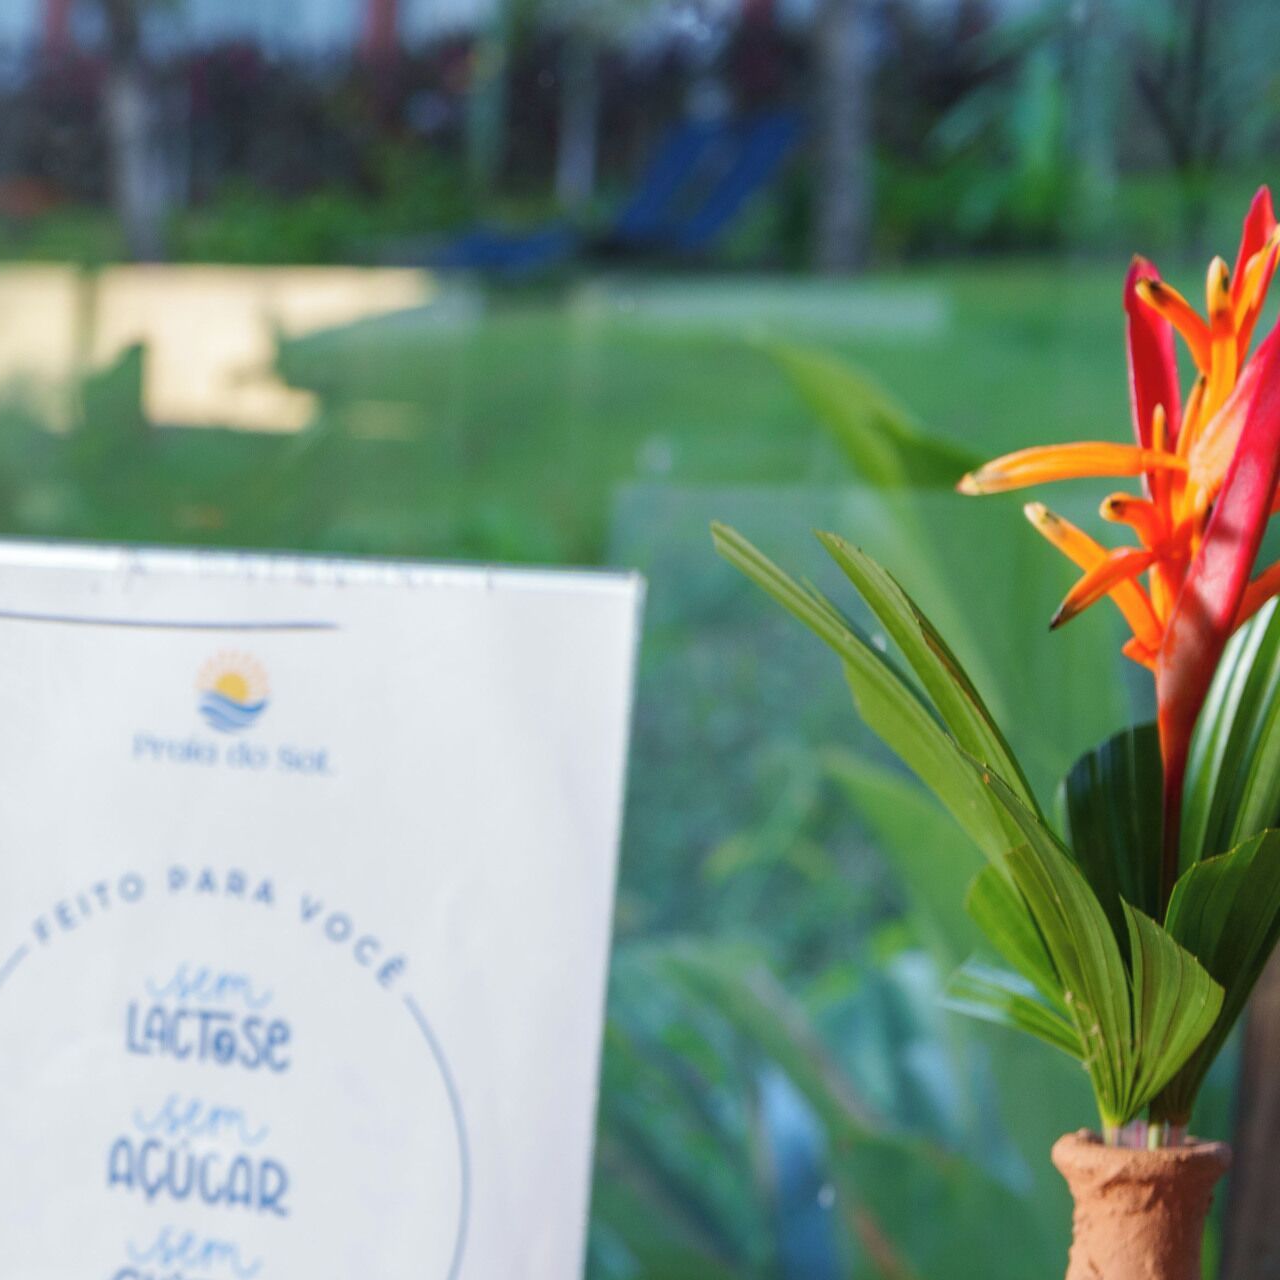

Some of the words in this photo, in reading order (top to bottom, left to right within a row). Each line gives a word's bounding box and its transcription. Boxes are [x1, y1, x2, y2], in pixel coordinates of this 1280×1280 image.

[32, 872, 144, 945] FEITO
[167, 867, 276, 906] PARA
[299, 895, 409, 988] VOCÊ
[107, 1135, 291, 1217] AÇÚCAR
